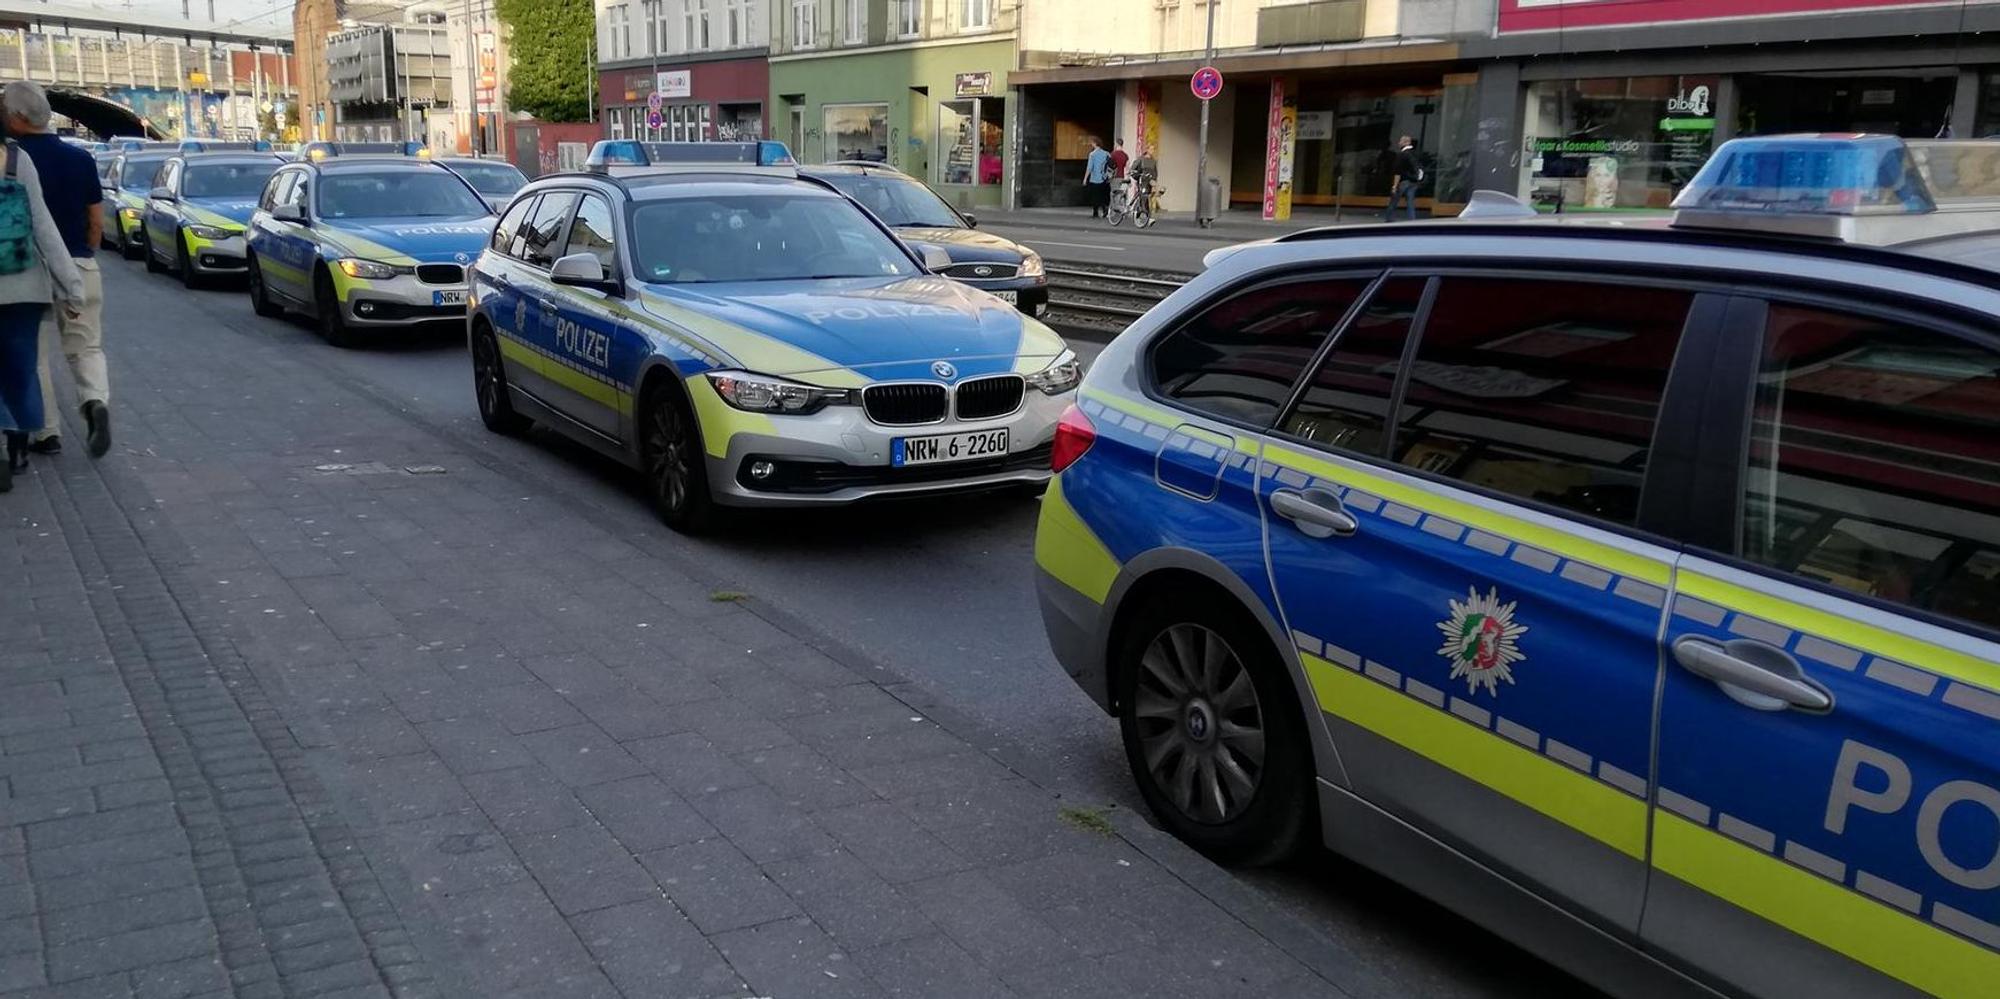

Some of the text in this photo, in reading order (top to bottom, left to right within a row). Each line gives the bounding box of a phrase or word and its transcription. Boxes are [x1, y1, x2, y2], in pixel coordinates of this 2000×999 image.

[440, 291, 460, 304] NRW
[556, 317, 610, 369] POLIZEI
[904, 431, 1007, 462] NRW 6-2260
[1824, 738, 2000, 890] PO
